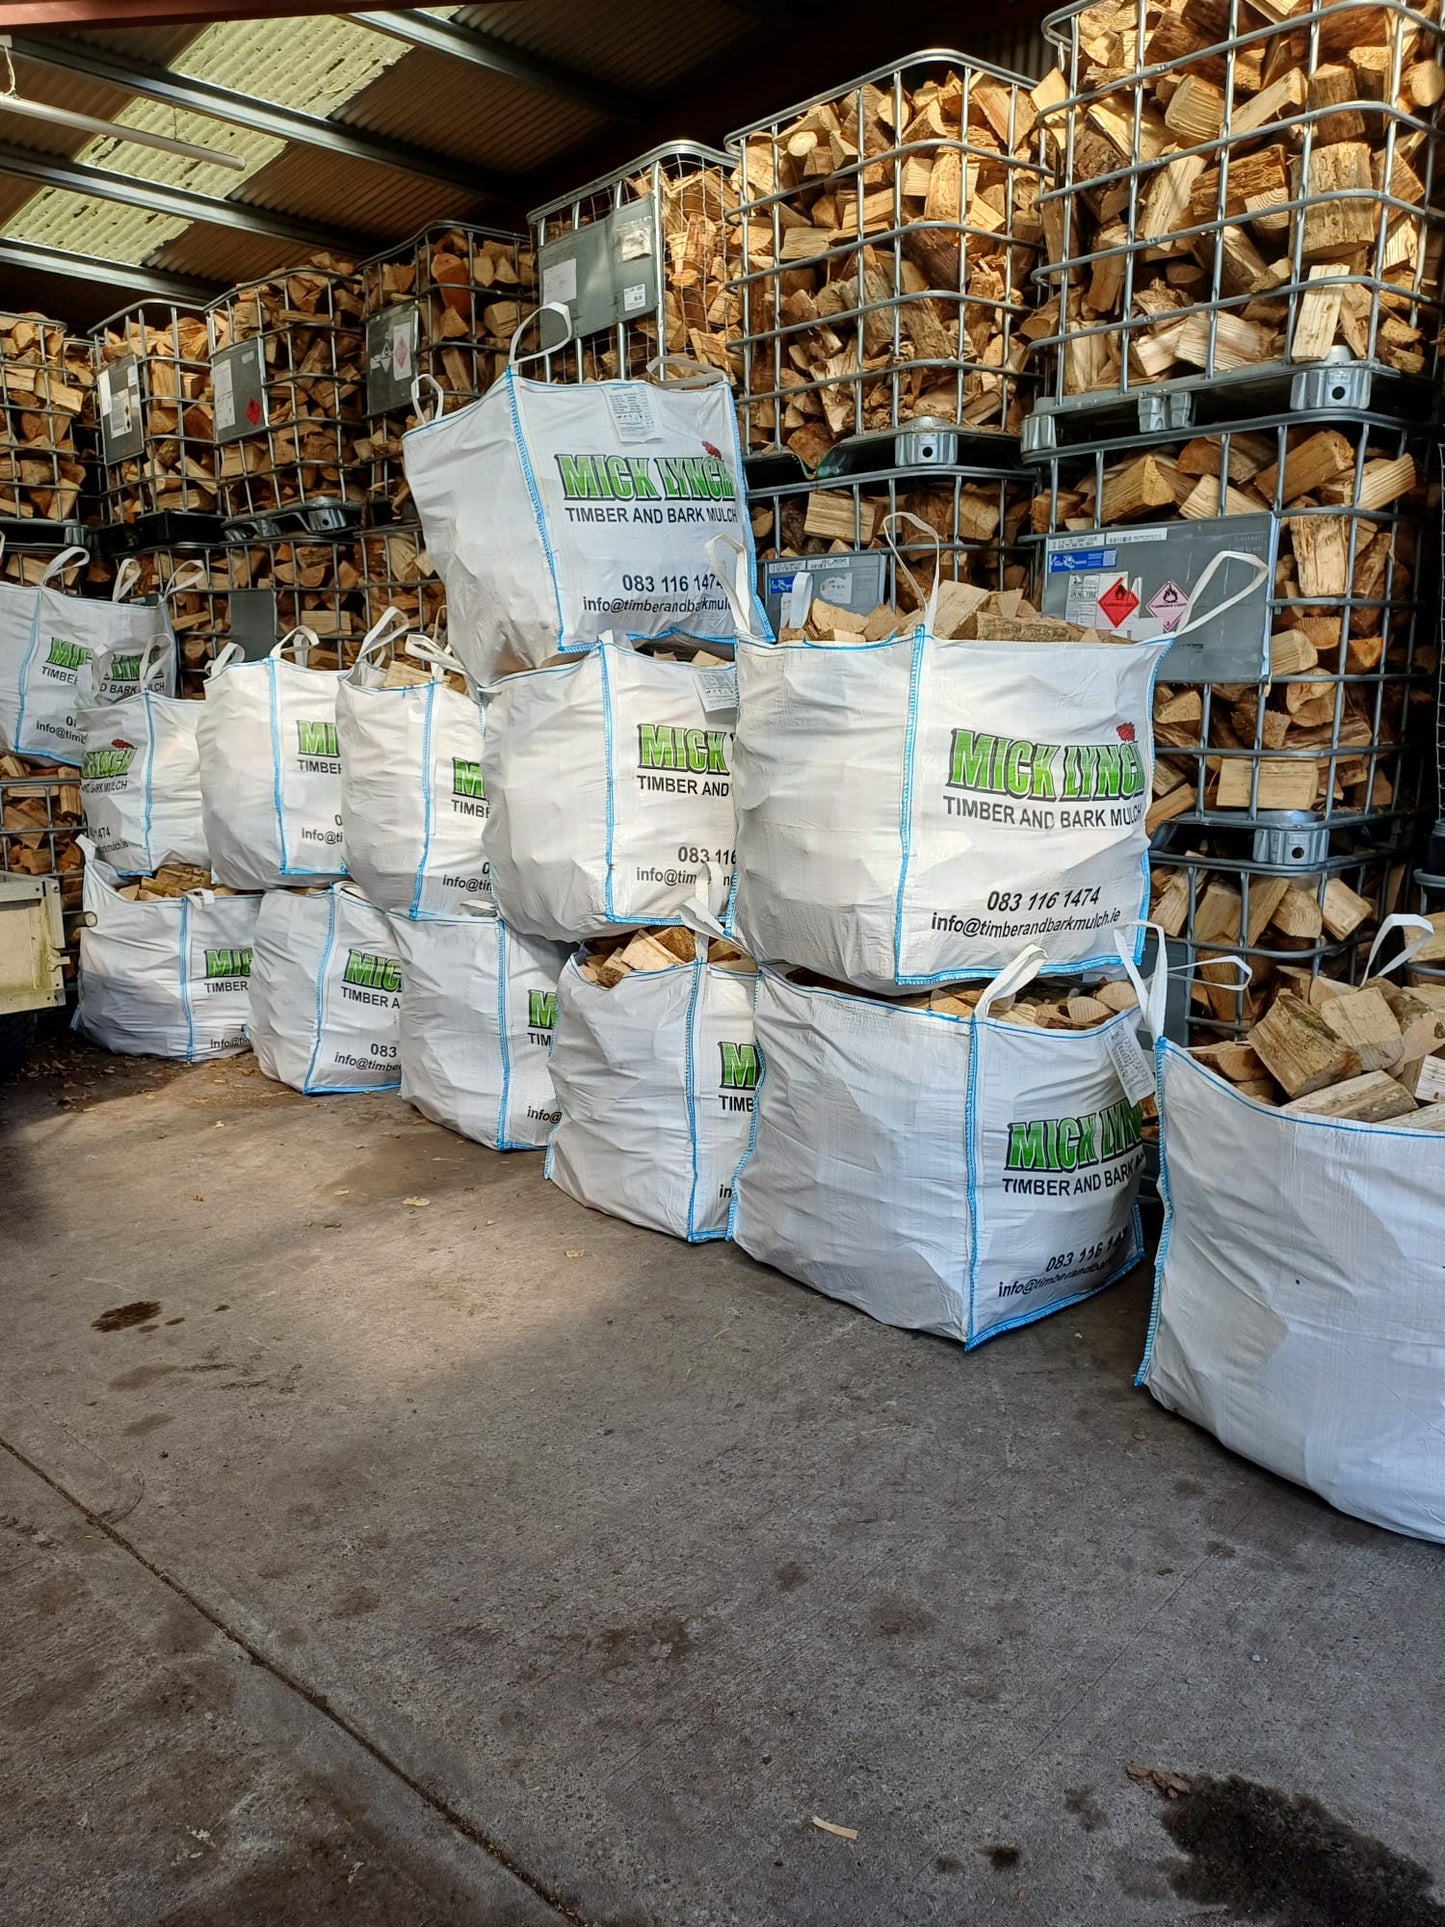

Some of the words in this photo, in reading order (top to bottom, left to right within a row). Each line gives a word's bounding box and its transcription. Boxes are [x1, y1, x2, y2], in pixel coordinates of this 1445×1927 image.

[554, 453, 662, 502] MICK
[565, 507, 629, 523] TIMBER
[632, 507, 664, 524] AND
[667, 507, 706, 523] BARK
[708, 508, 738, 523] MULCH
[622, 574, 655, 593] 083
[661, 575, 689, 593] 116
[110, 684, 137, 695] BARK
[637, 723, 731, 776] MICK
[945, 727, 1061, 802] MICK
[637, 775, 698, 795] TIMBER
[701, 781, 730, 797] AND
[943, 795, 1015, 825] TIMBER
[1019, 808, 1055, 830] AND
[1060, 808, 1106, 829] BARK
[678, 846, 710, 864] 083
[987, 890, 1023, 912] 083
[1027, 891, 1059, 911] 116
[1062, 886, 1102, 908] 1474
[931, 907, 1121, 938] info@timberandbarkmulch.ie
[204, 981, 249, 993] TIMBER
[340, 986, 389, 1008] TIMBER
[370, 1043, 398, 1058] 083
[1004, 1112, 1100, 1174] MICK
[1002, 1177, 1070, 1197] TIMBER
[1073, 1174, 1101, 1196] AND
[1104, 1158, 1135, 1188] BARK
[1045, 1251, 1075, 1273] 083
[1079, 1241, 1104, 1263] 116
